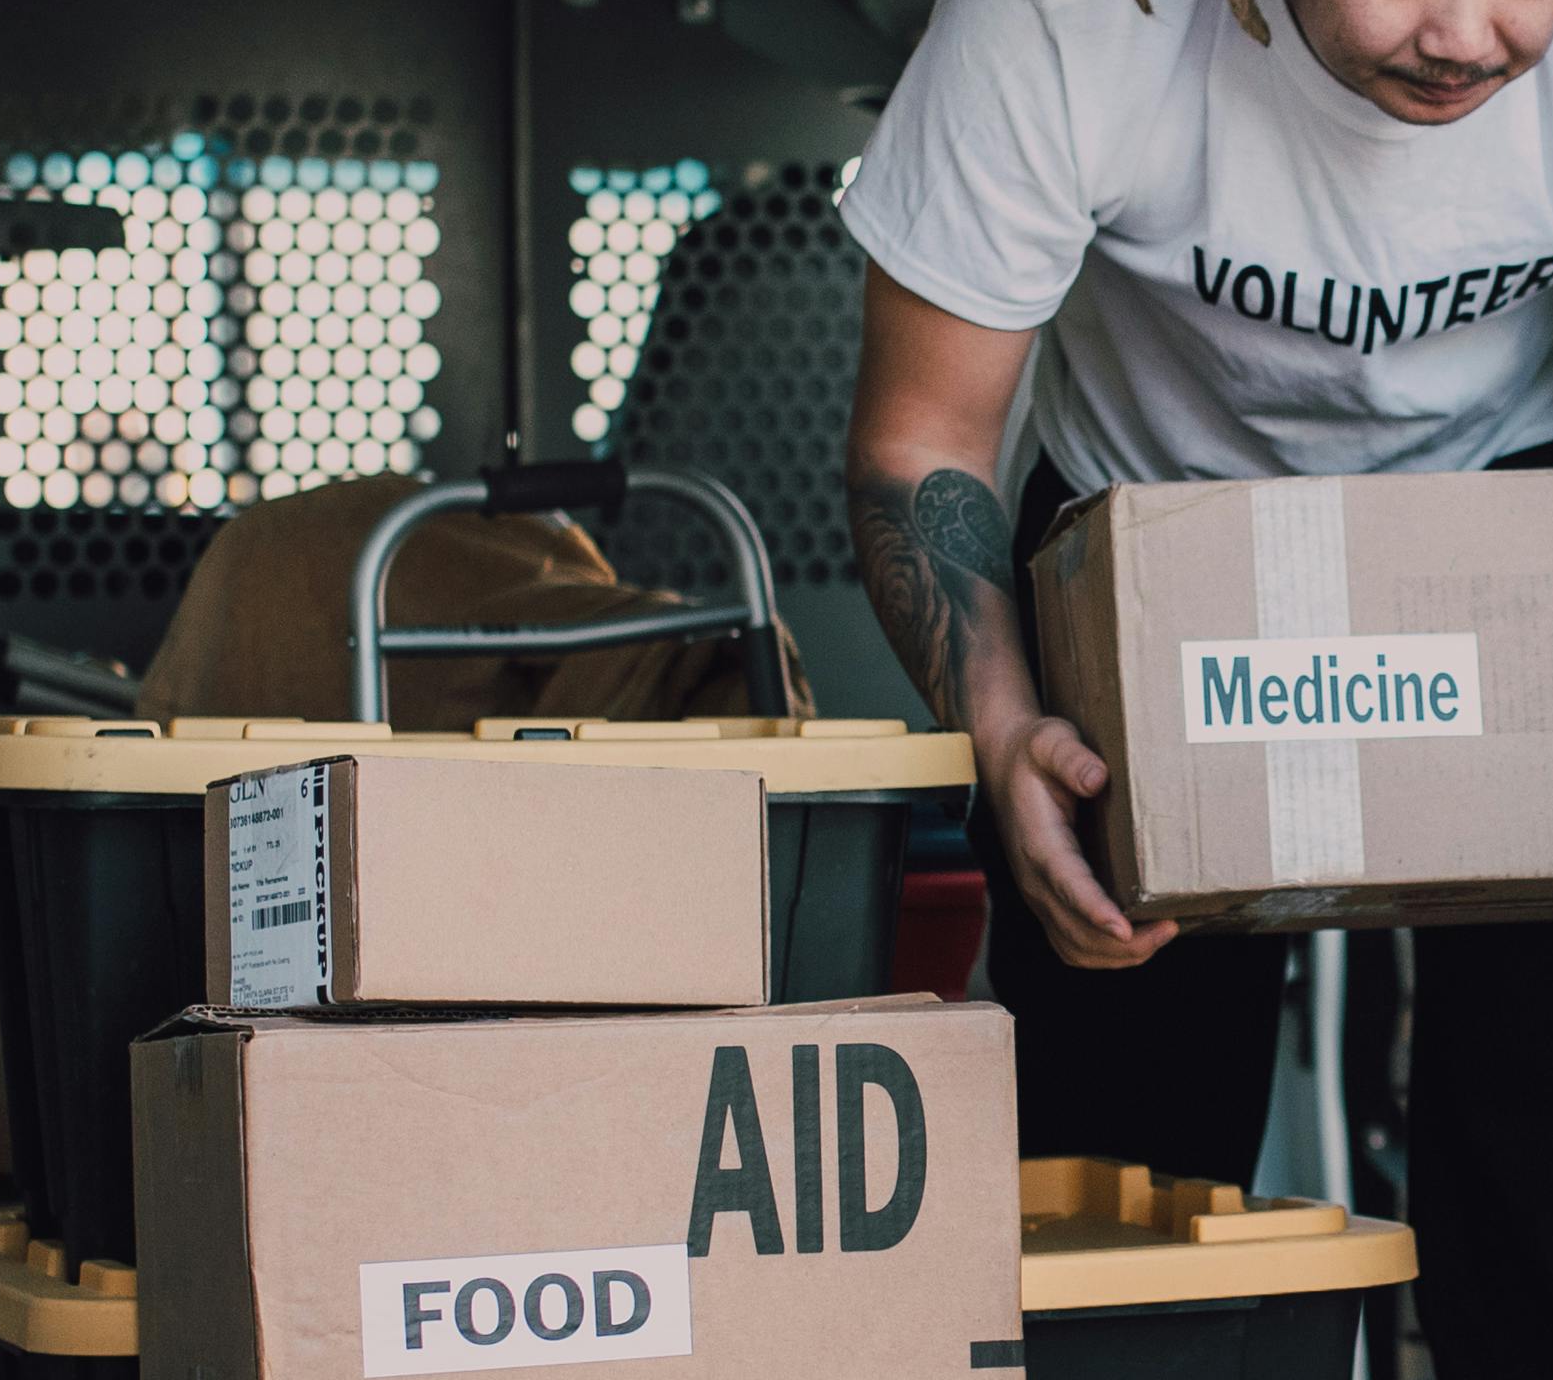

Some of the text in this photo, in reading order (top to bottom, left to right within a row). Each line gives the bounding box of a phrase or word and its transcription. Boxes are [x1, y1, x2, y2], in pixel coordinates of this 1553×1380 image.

[1201, 654, 1459, 726] Medicine
[300, 777, 309, 799] 6
[314, 813, 328, 978] PICKUP
[687, 1043, 927, 1258] AID
[402, 1269, 652, 1350] FOOD
